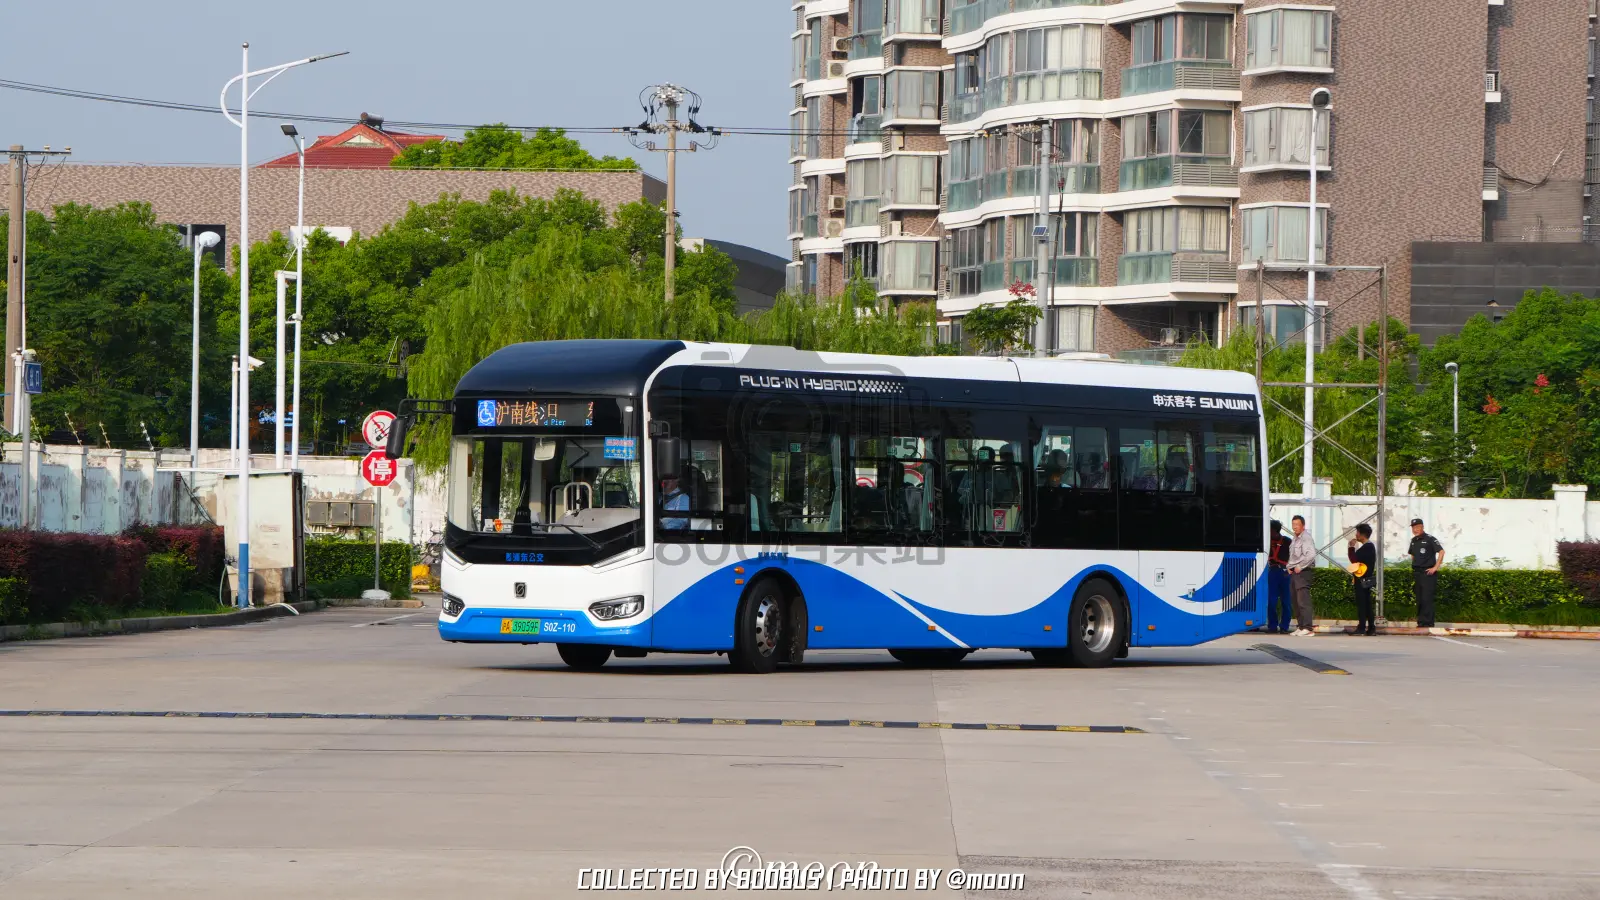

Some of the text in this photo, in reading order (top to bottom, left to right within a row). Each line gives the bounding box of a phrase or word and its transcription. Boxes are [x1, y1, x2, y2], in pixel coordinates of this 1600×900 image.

[740, 375, 857, 391] PLUG-IN HYBRID
[1153, 394, 1196, 408] 申沃客车
[1200, 397, 1254, 411] SUNWIN
[496, 401, 539, 426] 沪南线
[368, 457, 392, 481] 停
